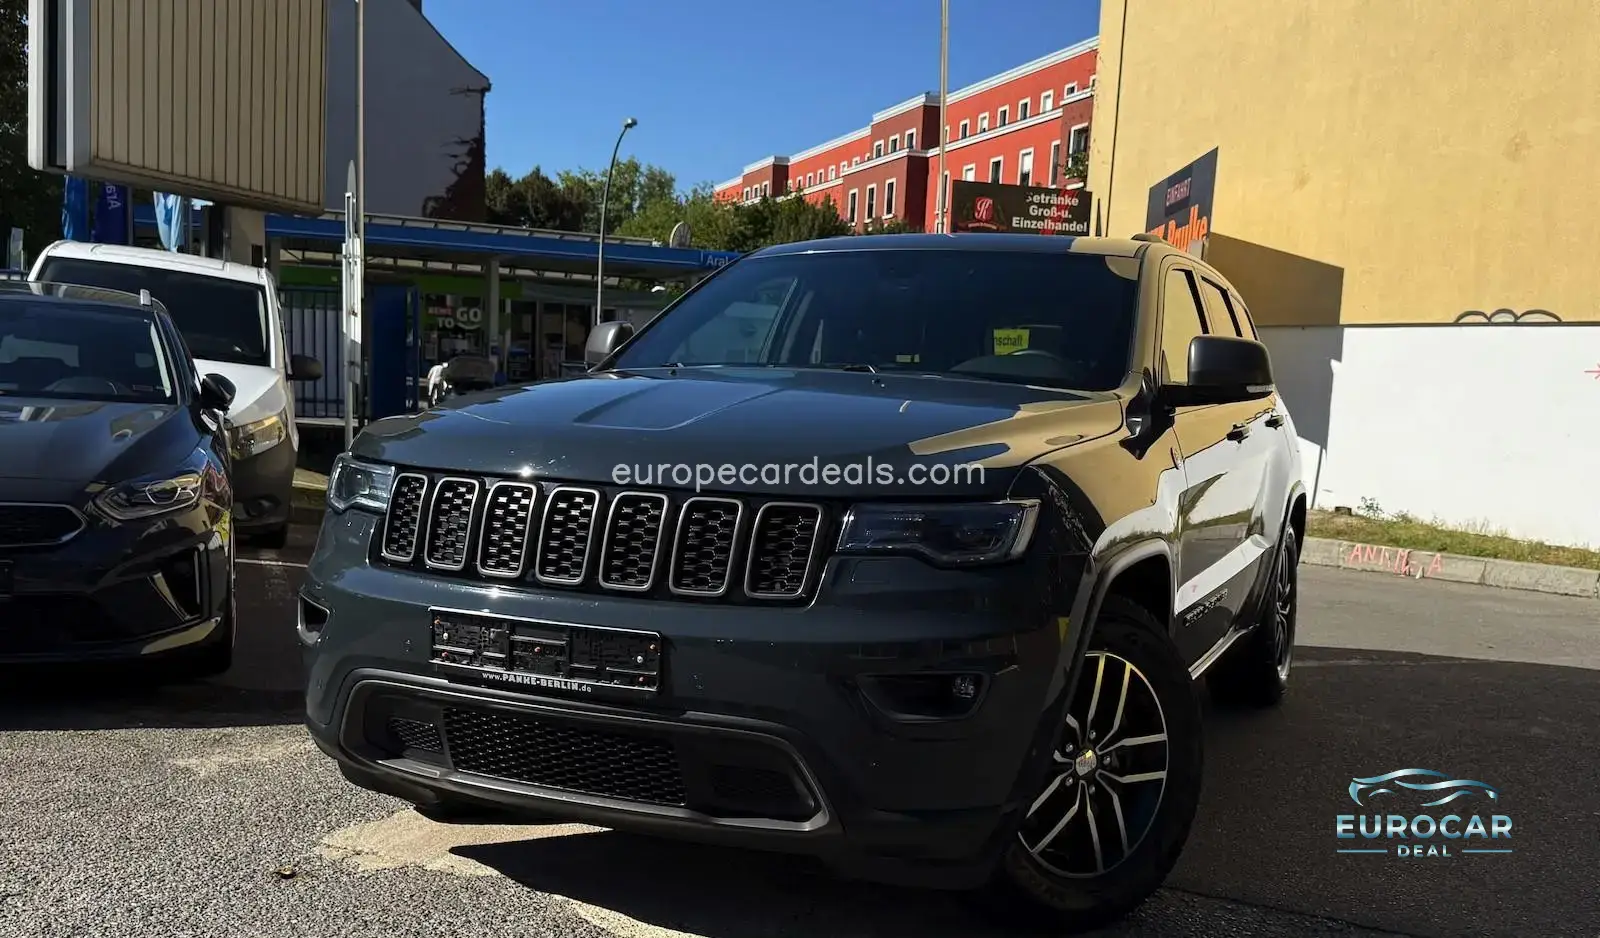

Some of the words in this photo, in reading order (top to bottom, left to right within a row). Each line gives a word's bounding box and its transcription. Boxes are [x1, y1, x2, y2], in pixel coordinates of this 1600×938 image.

[1012, 217, 1087, 232] Einzelhandel
[706, 254, 729, 267] Aral
[437, 317, 455, 329] TO
[456, 307, 482, 322] GO
